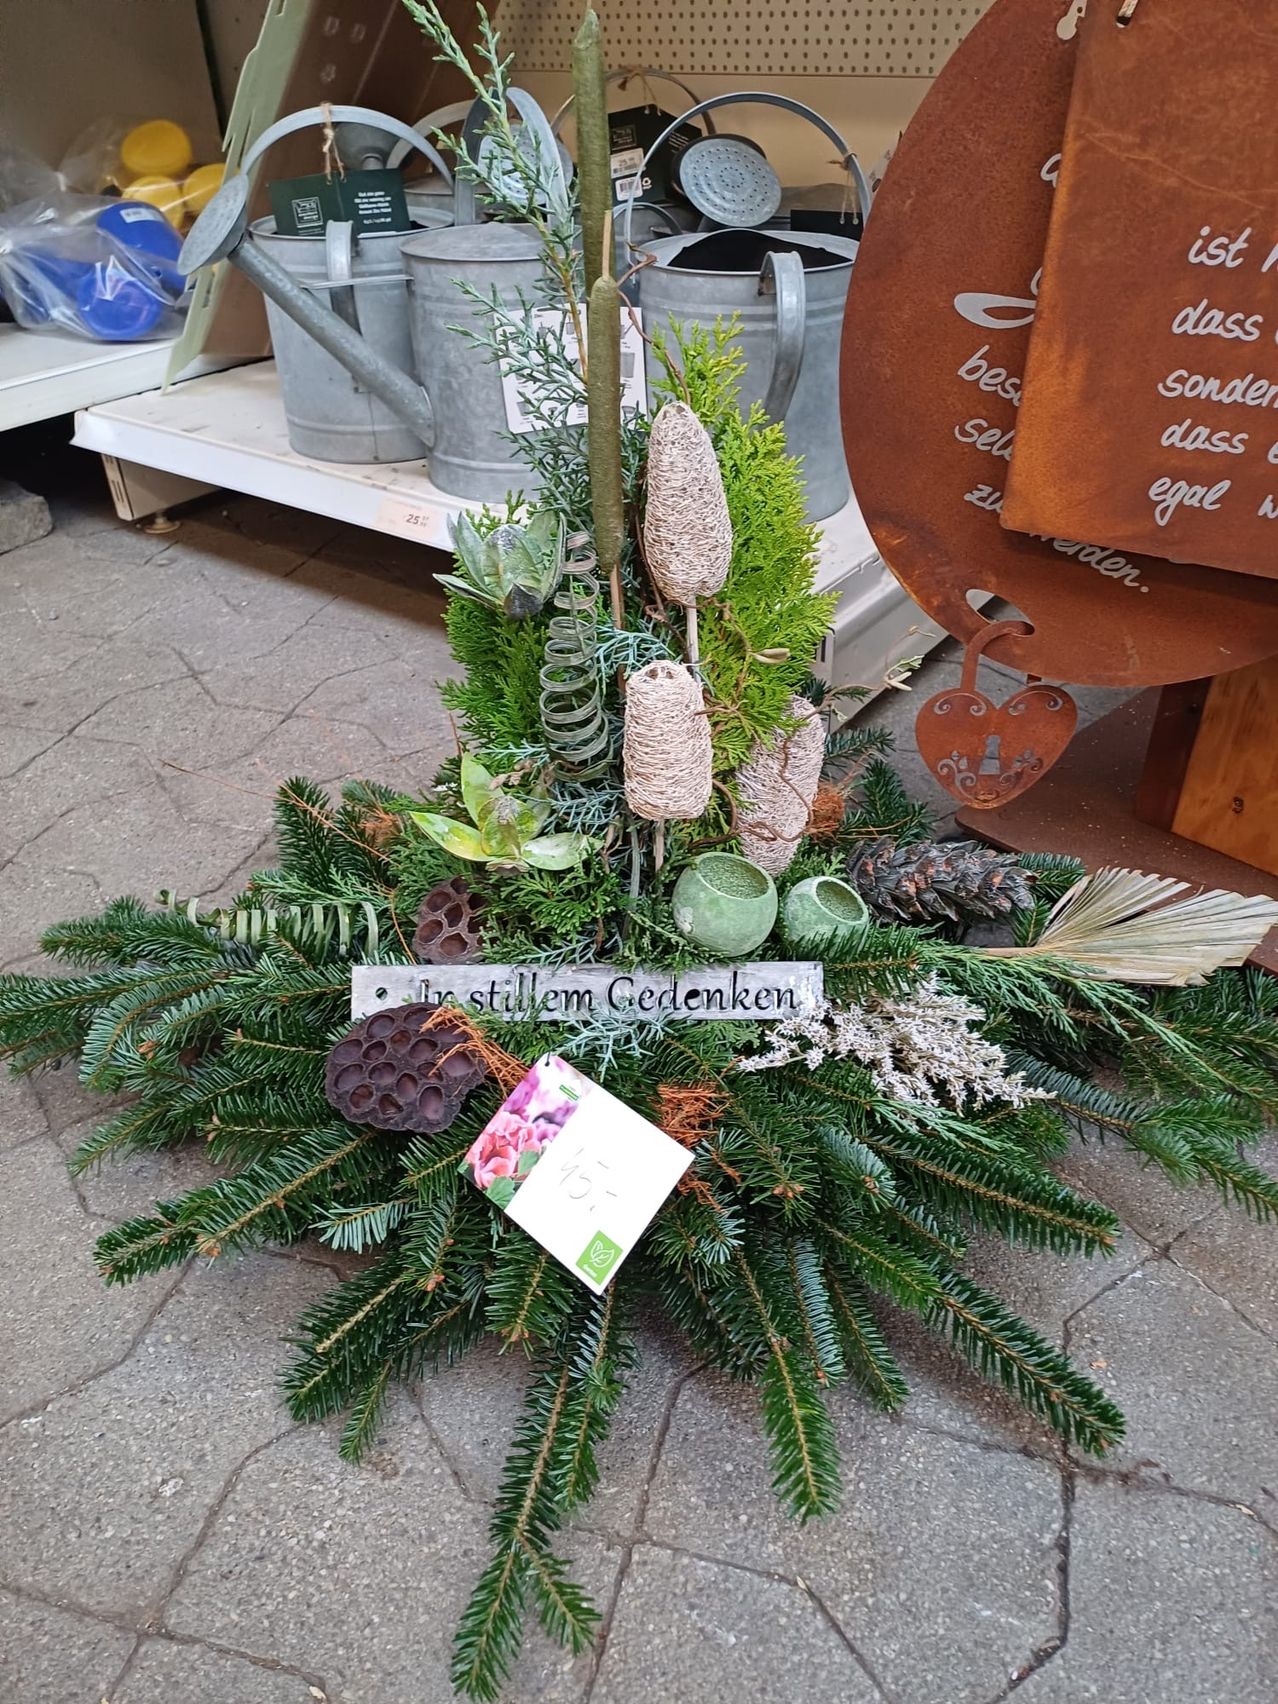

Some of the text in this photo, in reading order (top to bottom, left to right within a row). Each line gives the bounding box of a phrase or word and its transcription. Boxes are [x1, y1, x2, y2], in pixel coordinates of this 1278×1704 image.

[1188, 226, 1252, 268] ist
[1171, 298, 1264, 341] dass
[1160, 418, 1249, 454] dass
[1148, 476, 1232, 526] egal
[1029, 533, 1150, 593] erden.
[469, 971, 594, 1013] stillem
[607, 970, 797, 1012] Gedenken
